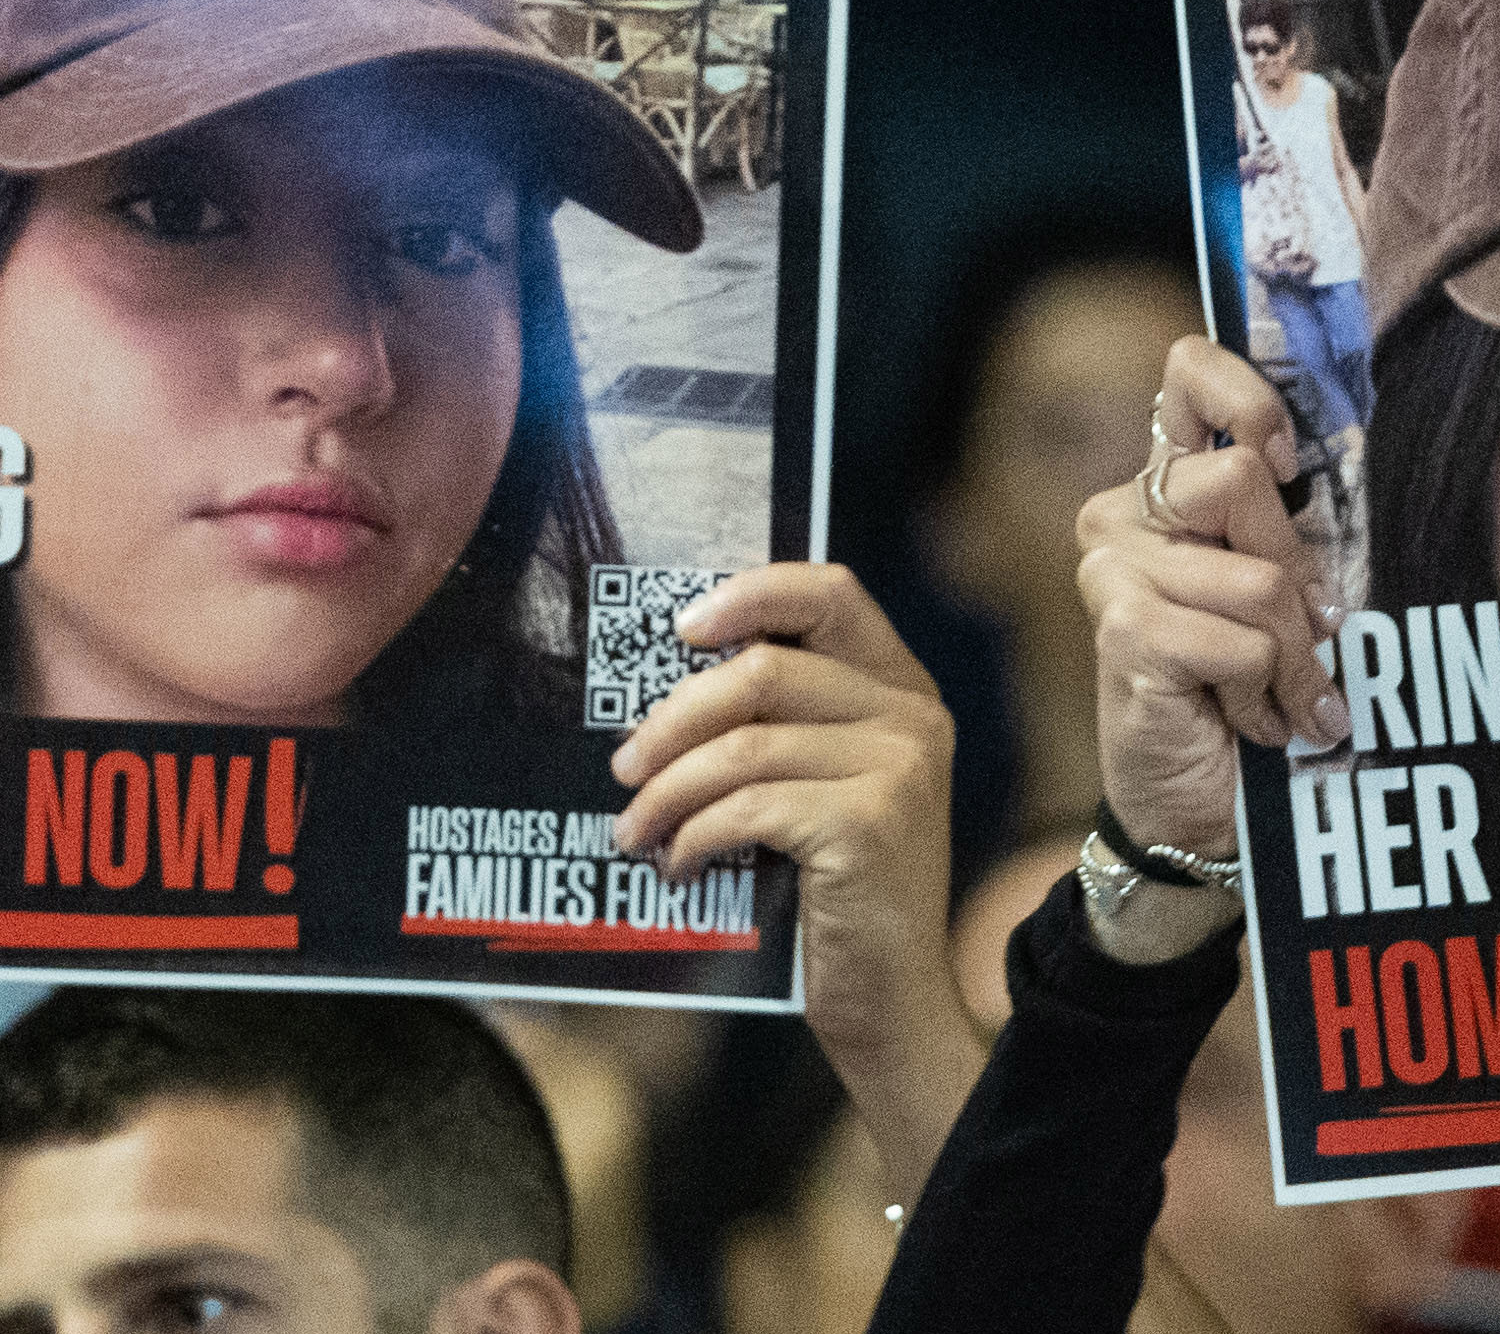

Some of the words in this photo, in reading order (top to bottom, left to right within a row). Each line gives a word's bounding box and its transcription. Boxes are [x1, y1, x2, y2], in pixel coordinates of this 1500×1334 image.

[23, 736, 297, 896] NOW!
[406, 804, 559, 856] HOSTAGES
[561, 811, 620, 859] AND
[1289, 764, 1493, 918] HER
[404, 852, 598, 927] FAMILIES
[604, 863, 757, 935] FORUM
